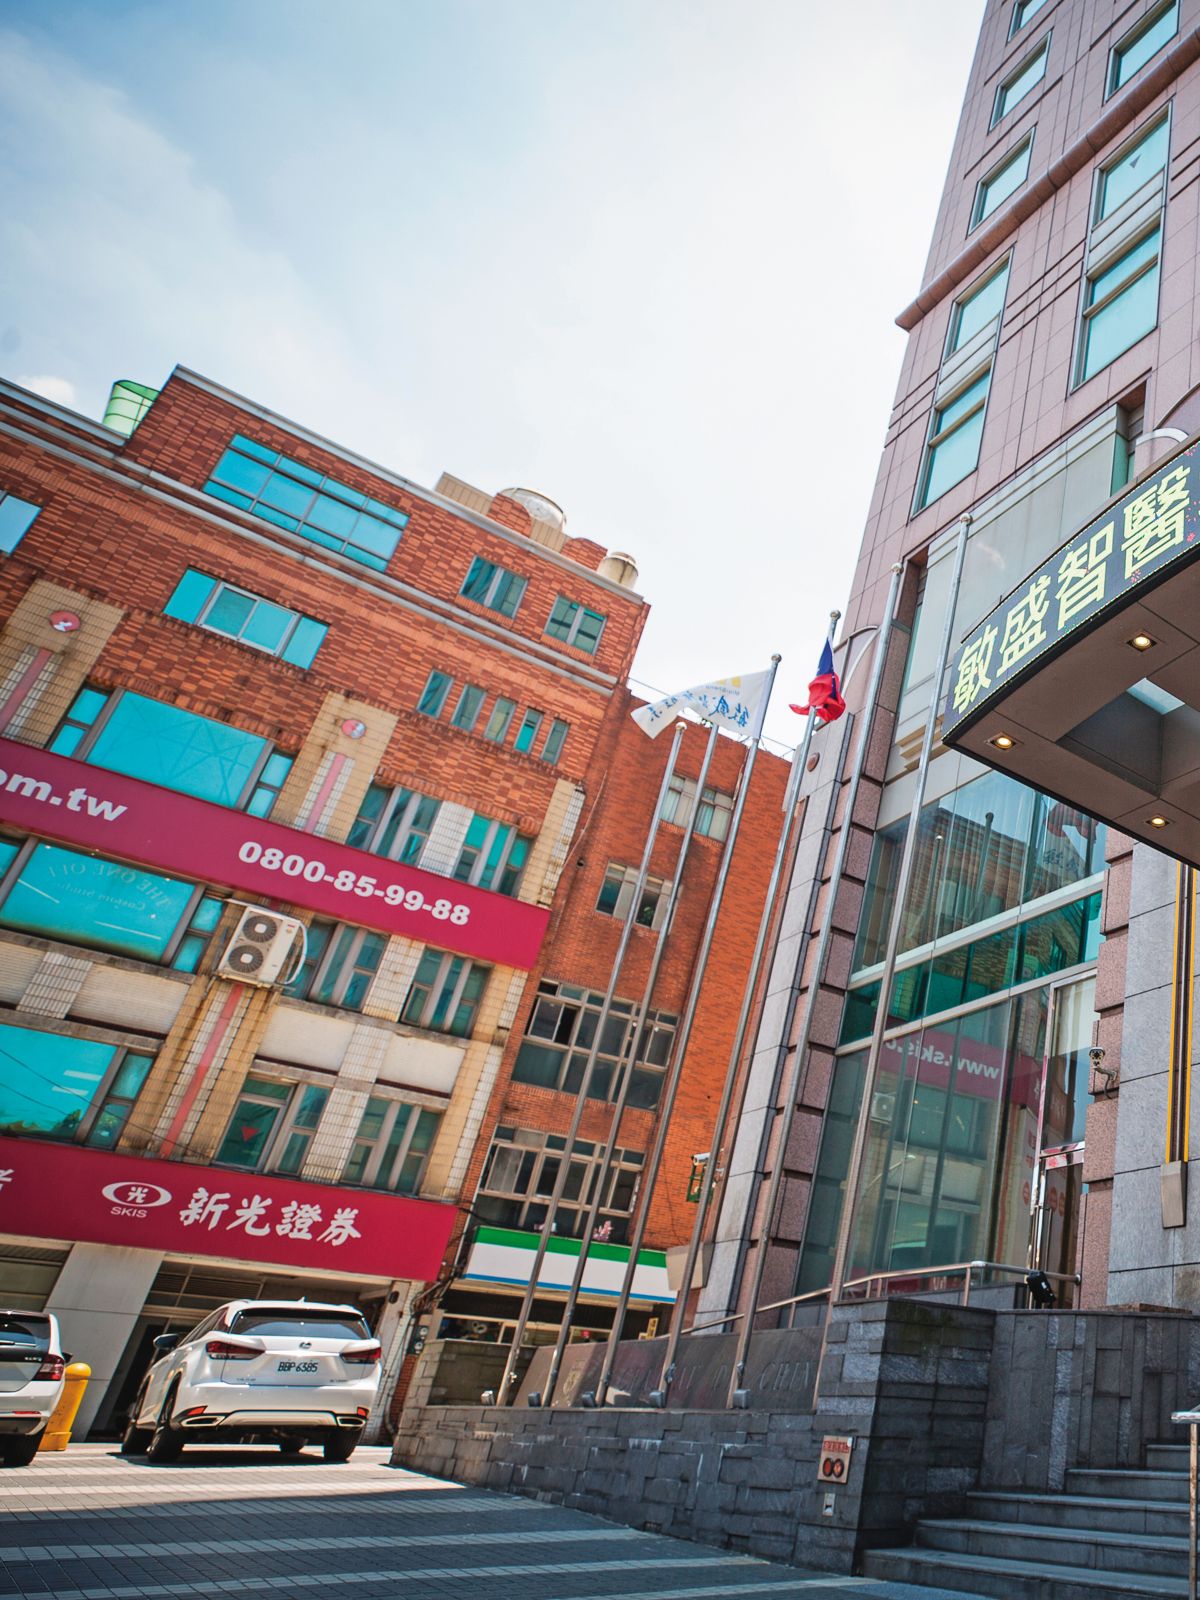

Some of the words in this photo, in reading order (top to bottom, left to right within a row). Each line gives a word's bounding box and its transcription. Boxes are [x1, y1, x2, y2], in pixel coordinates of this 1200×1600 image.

[238, 841, 471, 926] 0800-85-99-88
[110, 1206, 148, 1219] SKIS
[179, 1187, 362, 1247] 新光證券
